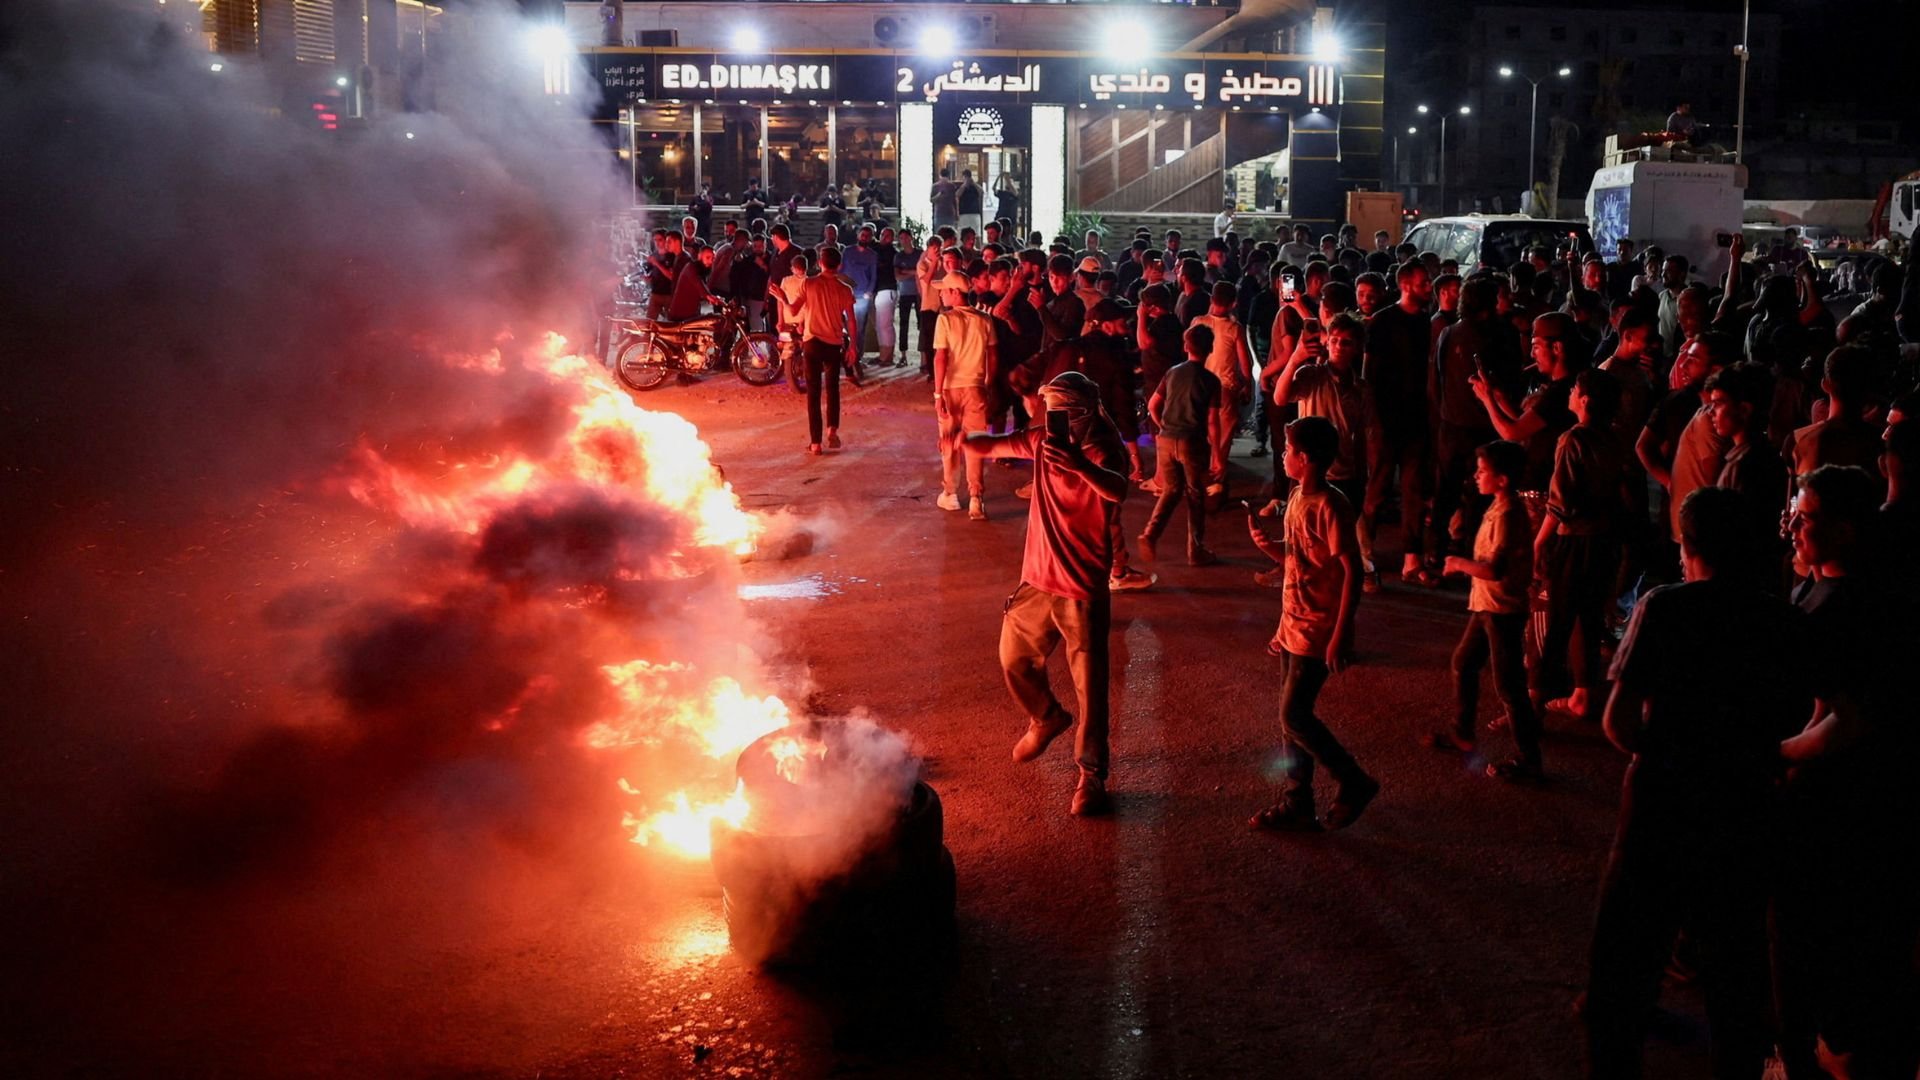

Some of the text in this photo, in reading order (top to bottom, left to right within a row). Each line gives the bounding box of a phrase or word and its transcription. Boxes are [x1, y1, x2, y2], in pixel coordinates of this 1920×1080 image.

[896, 61, 1041, 103] الدمشقي 2
[1090, 67, 1302, 102] مطبخ و مندي
